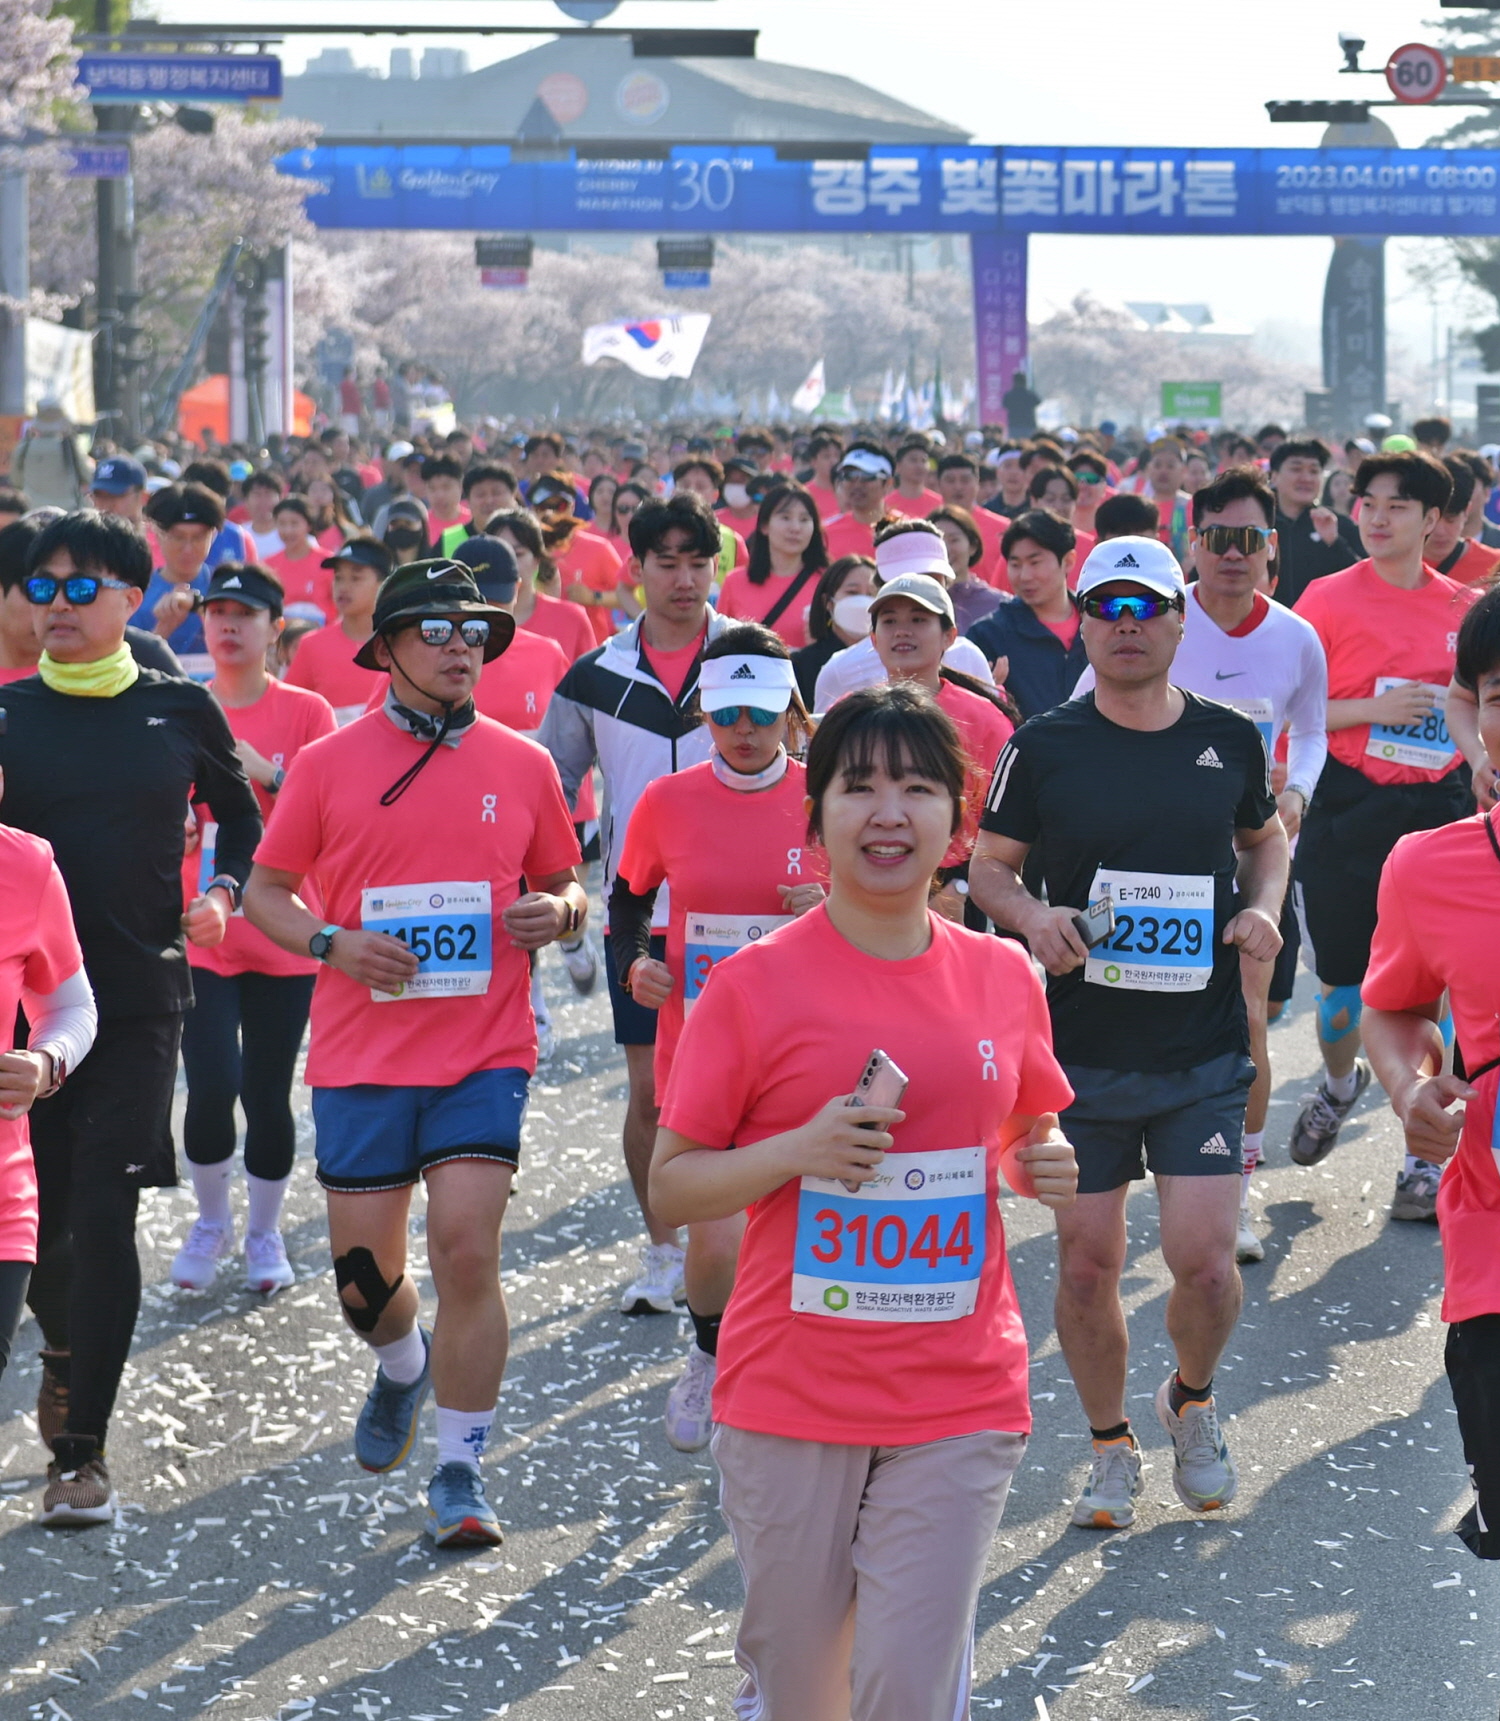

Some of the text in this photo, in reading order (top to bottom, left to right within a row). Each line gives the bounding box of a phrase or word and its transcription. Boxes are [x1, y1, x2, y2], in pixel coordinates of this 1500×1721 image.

[85, 65, 269, 90] 보덕동행정복지센터
[1397, 61, 1432, 87] 60
[1425, 165, 1497, 189] 08:00
[575, 178, 638, 193] CHERRY
[811, 158, 1237, 217] 경주 벚꽃마라톤
[575, 196, 663, 212] MARATHON
[1196, 758, 1223, 769] adidas
[1120, 886, 1161, 900] E-7240
[382, 924, 477, 962] 562
[1102, 915, 1202, 955] 2329
[1124, 969, 1192, 982] 한국원자력환경공단
[1200, 1146, 1231, 1156] adidas
[929, 1170, 974, 1183] 경주시체육회
[810, 1208, 974, 1269] 31044
[856, 1291, 956, 1306] 한국원자력환경공단
